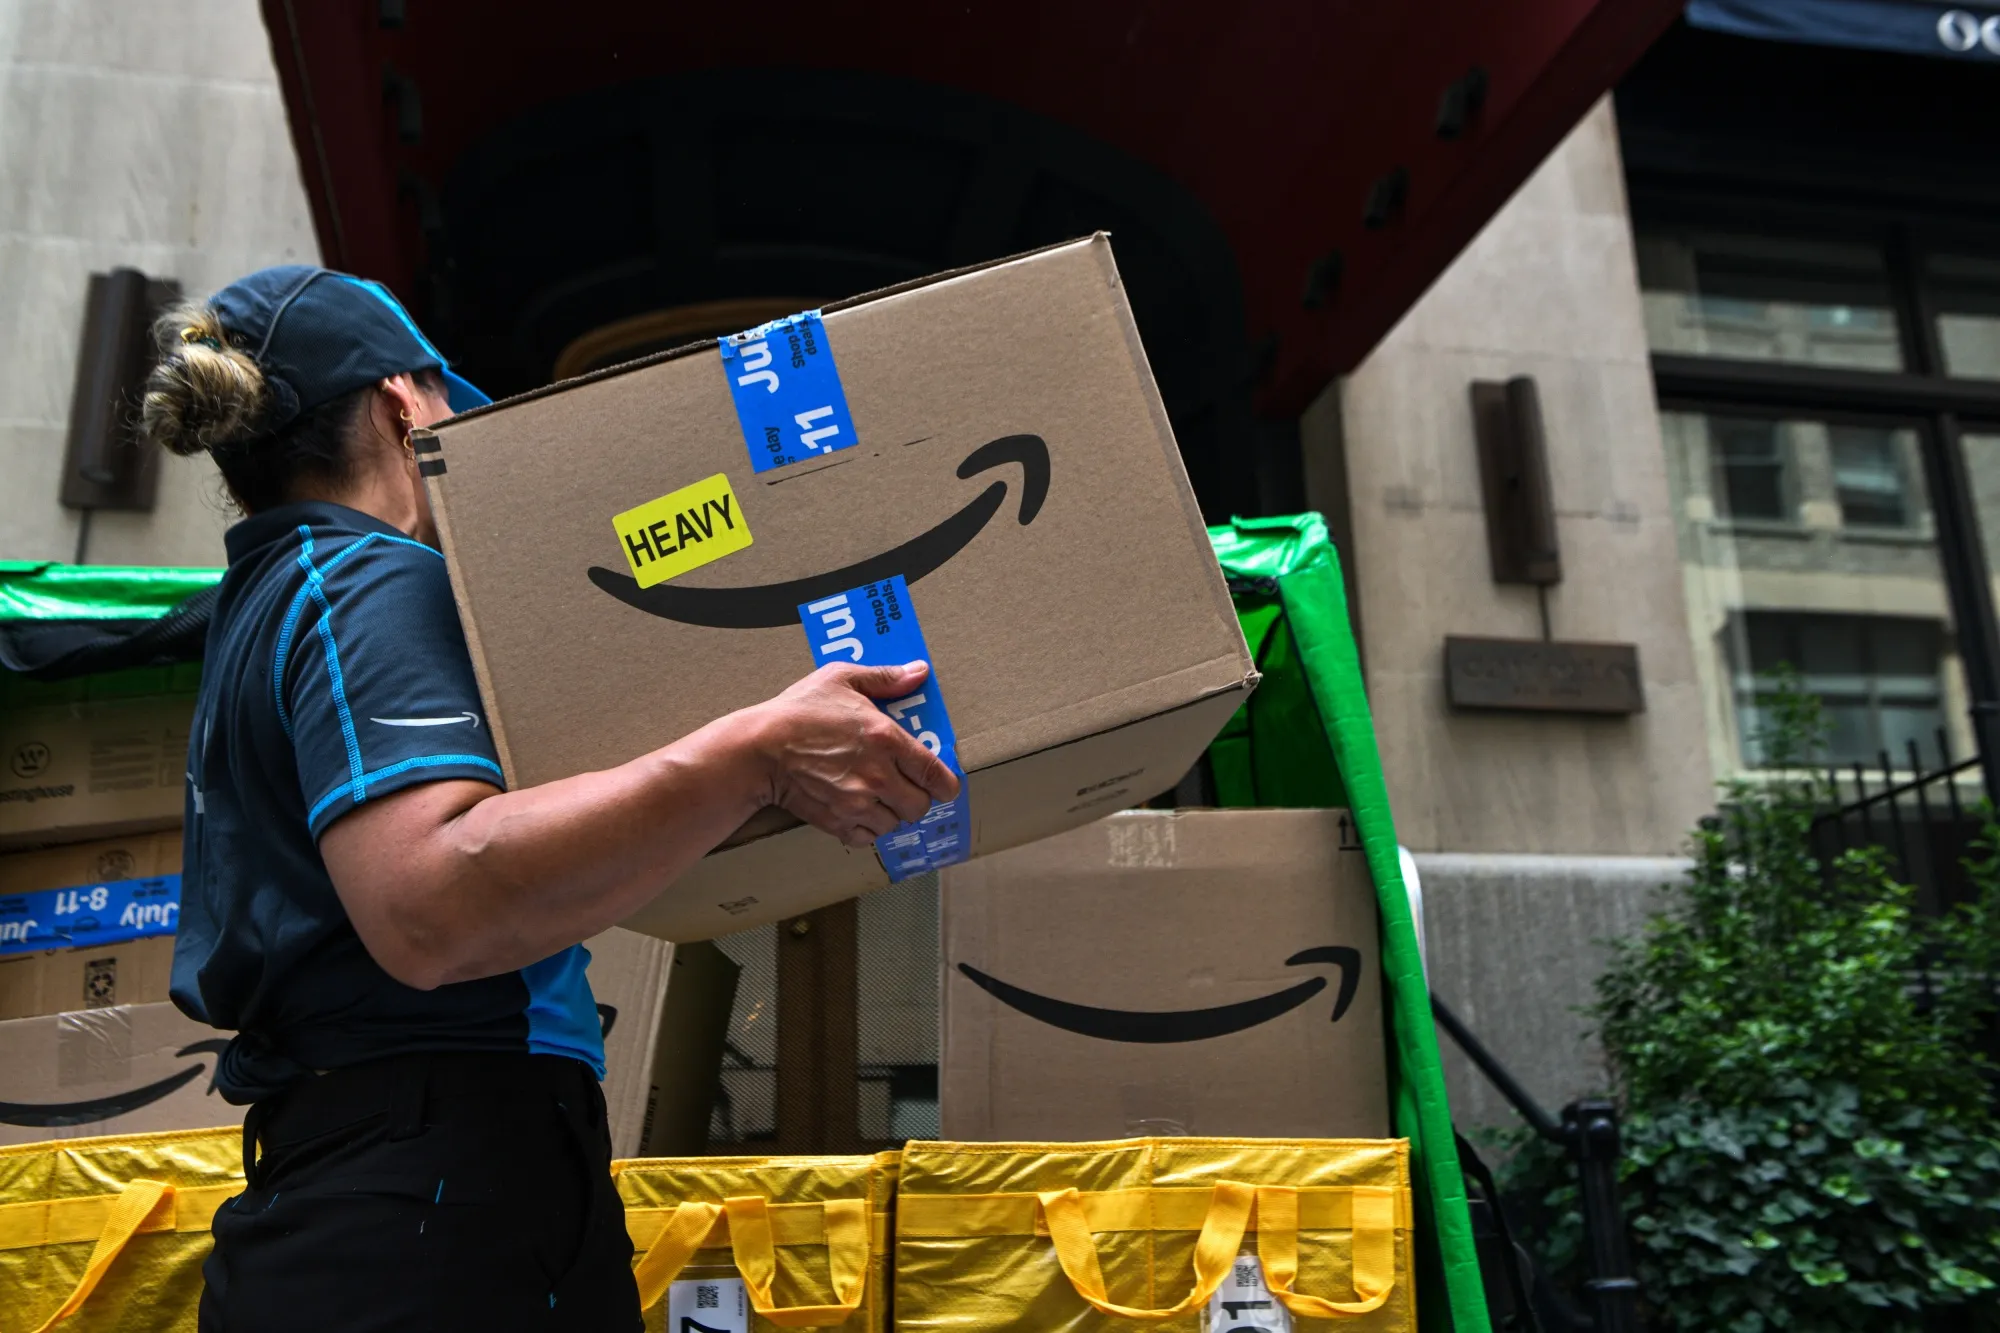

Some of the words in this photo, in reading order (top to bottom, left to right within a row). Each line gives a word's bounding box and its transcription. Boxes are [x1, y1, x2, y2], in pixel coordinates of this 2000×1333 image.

[788, 335, 806, 369] Shop
[764, 427, 782, 452] day
[625, 494, 735, 568] HEAVY
[882, 579, 903, 621] deals.
[807, 594, 864, 662] Jul
[872, 600, 890, 635] Shop
[55, 887, 109, 916] 8-11
[119, 902, 180, 930] July
[0, 920, 39, 943] Ju
